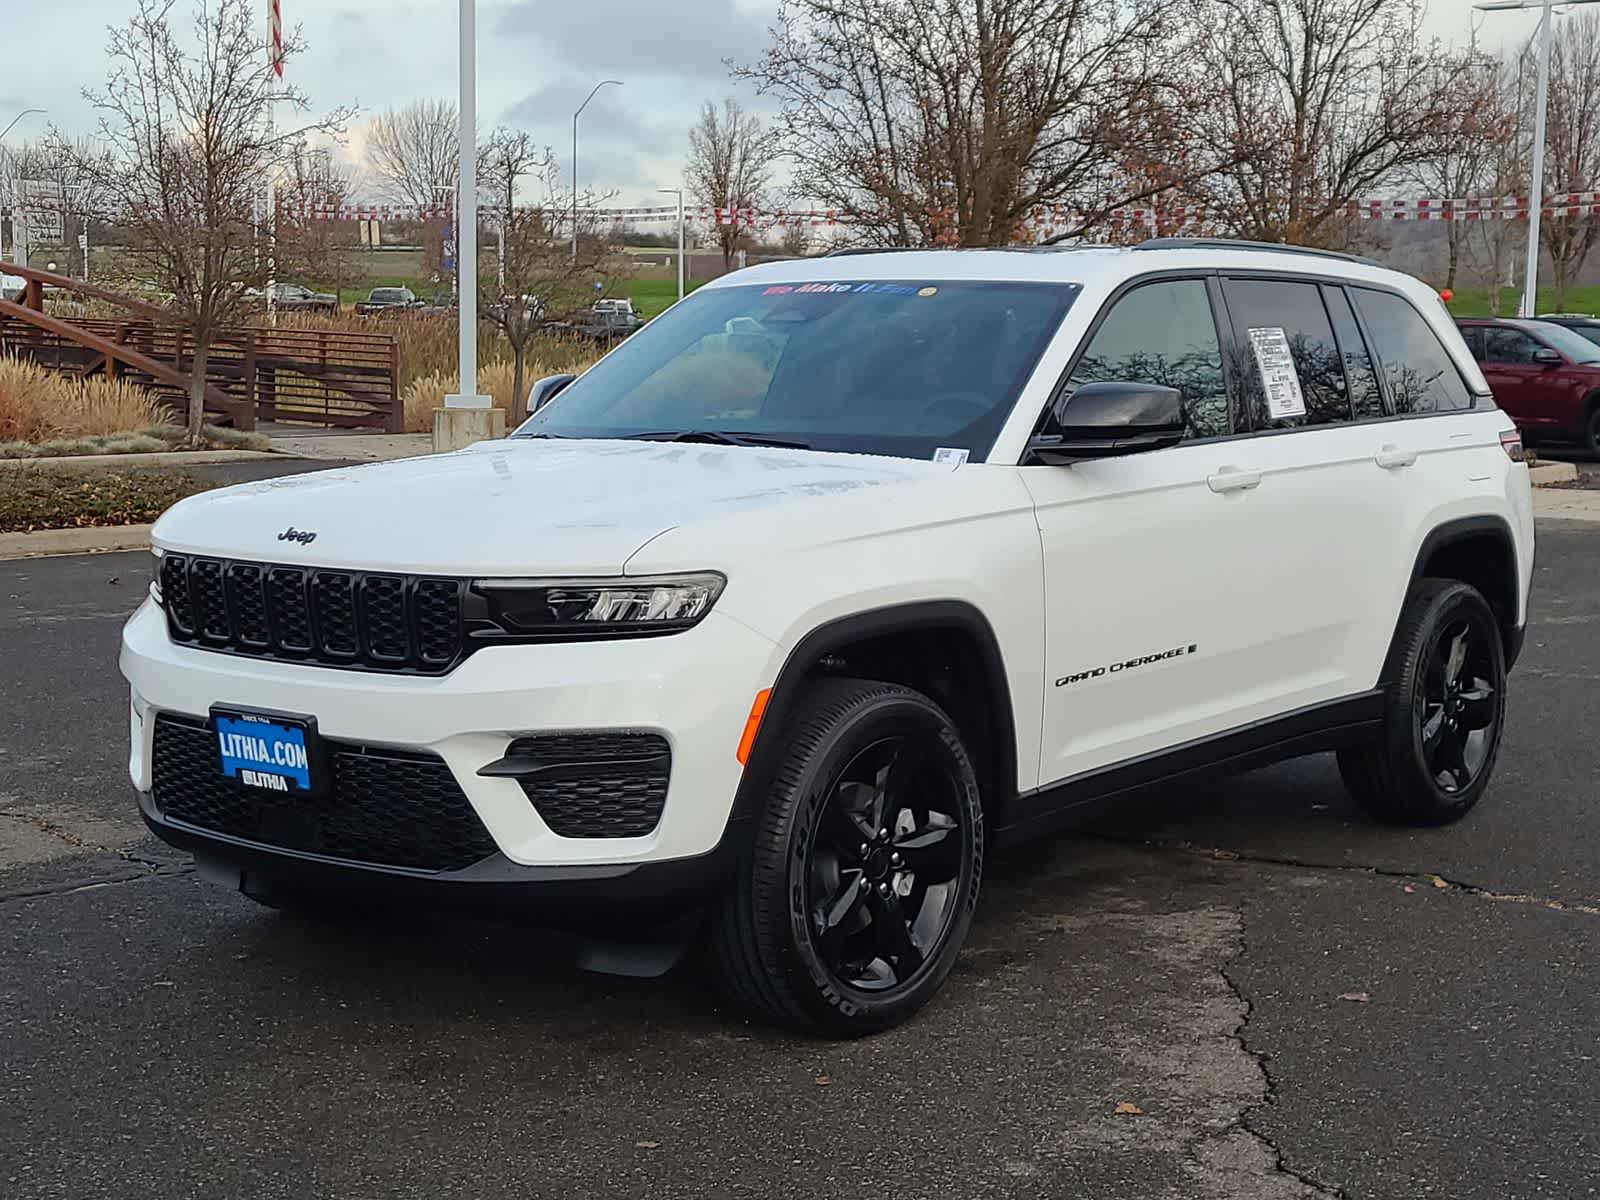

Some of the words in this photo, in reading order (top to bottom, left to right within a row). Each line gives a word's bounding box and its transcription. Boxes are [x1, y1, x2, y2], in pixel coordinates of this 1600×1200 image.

[794, 282, 852, 293] Make
[278, 527, 317, 546] Jeep
[1055, 667, 1106, 687] GRAND
[1109, 647, 1185, 673] CHEROKEE
[219, 732, 308, 770] LITHIA.COM
[252, 771, 288, 792] LITHIA
